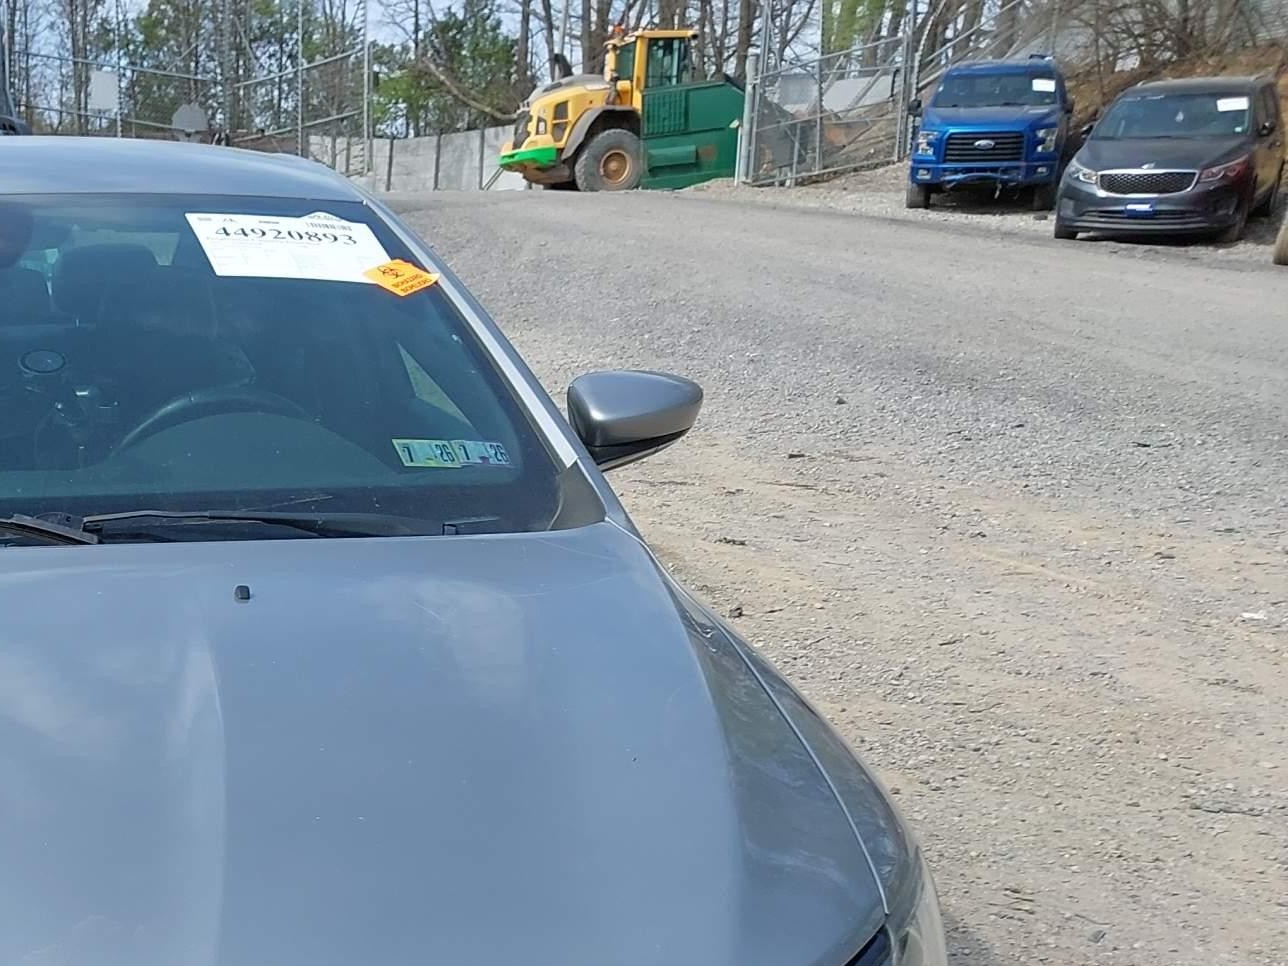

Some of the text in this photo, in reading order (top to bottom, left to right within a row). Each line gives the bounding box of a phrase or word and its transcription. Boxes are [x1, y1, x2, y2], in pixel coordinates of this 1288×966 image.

[215, 226, 358, 246] 44920893
[402, 444, 456, 463] 7 26
[459, 444, 509, 462] 7 26
